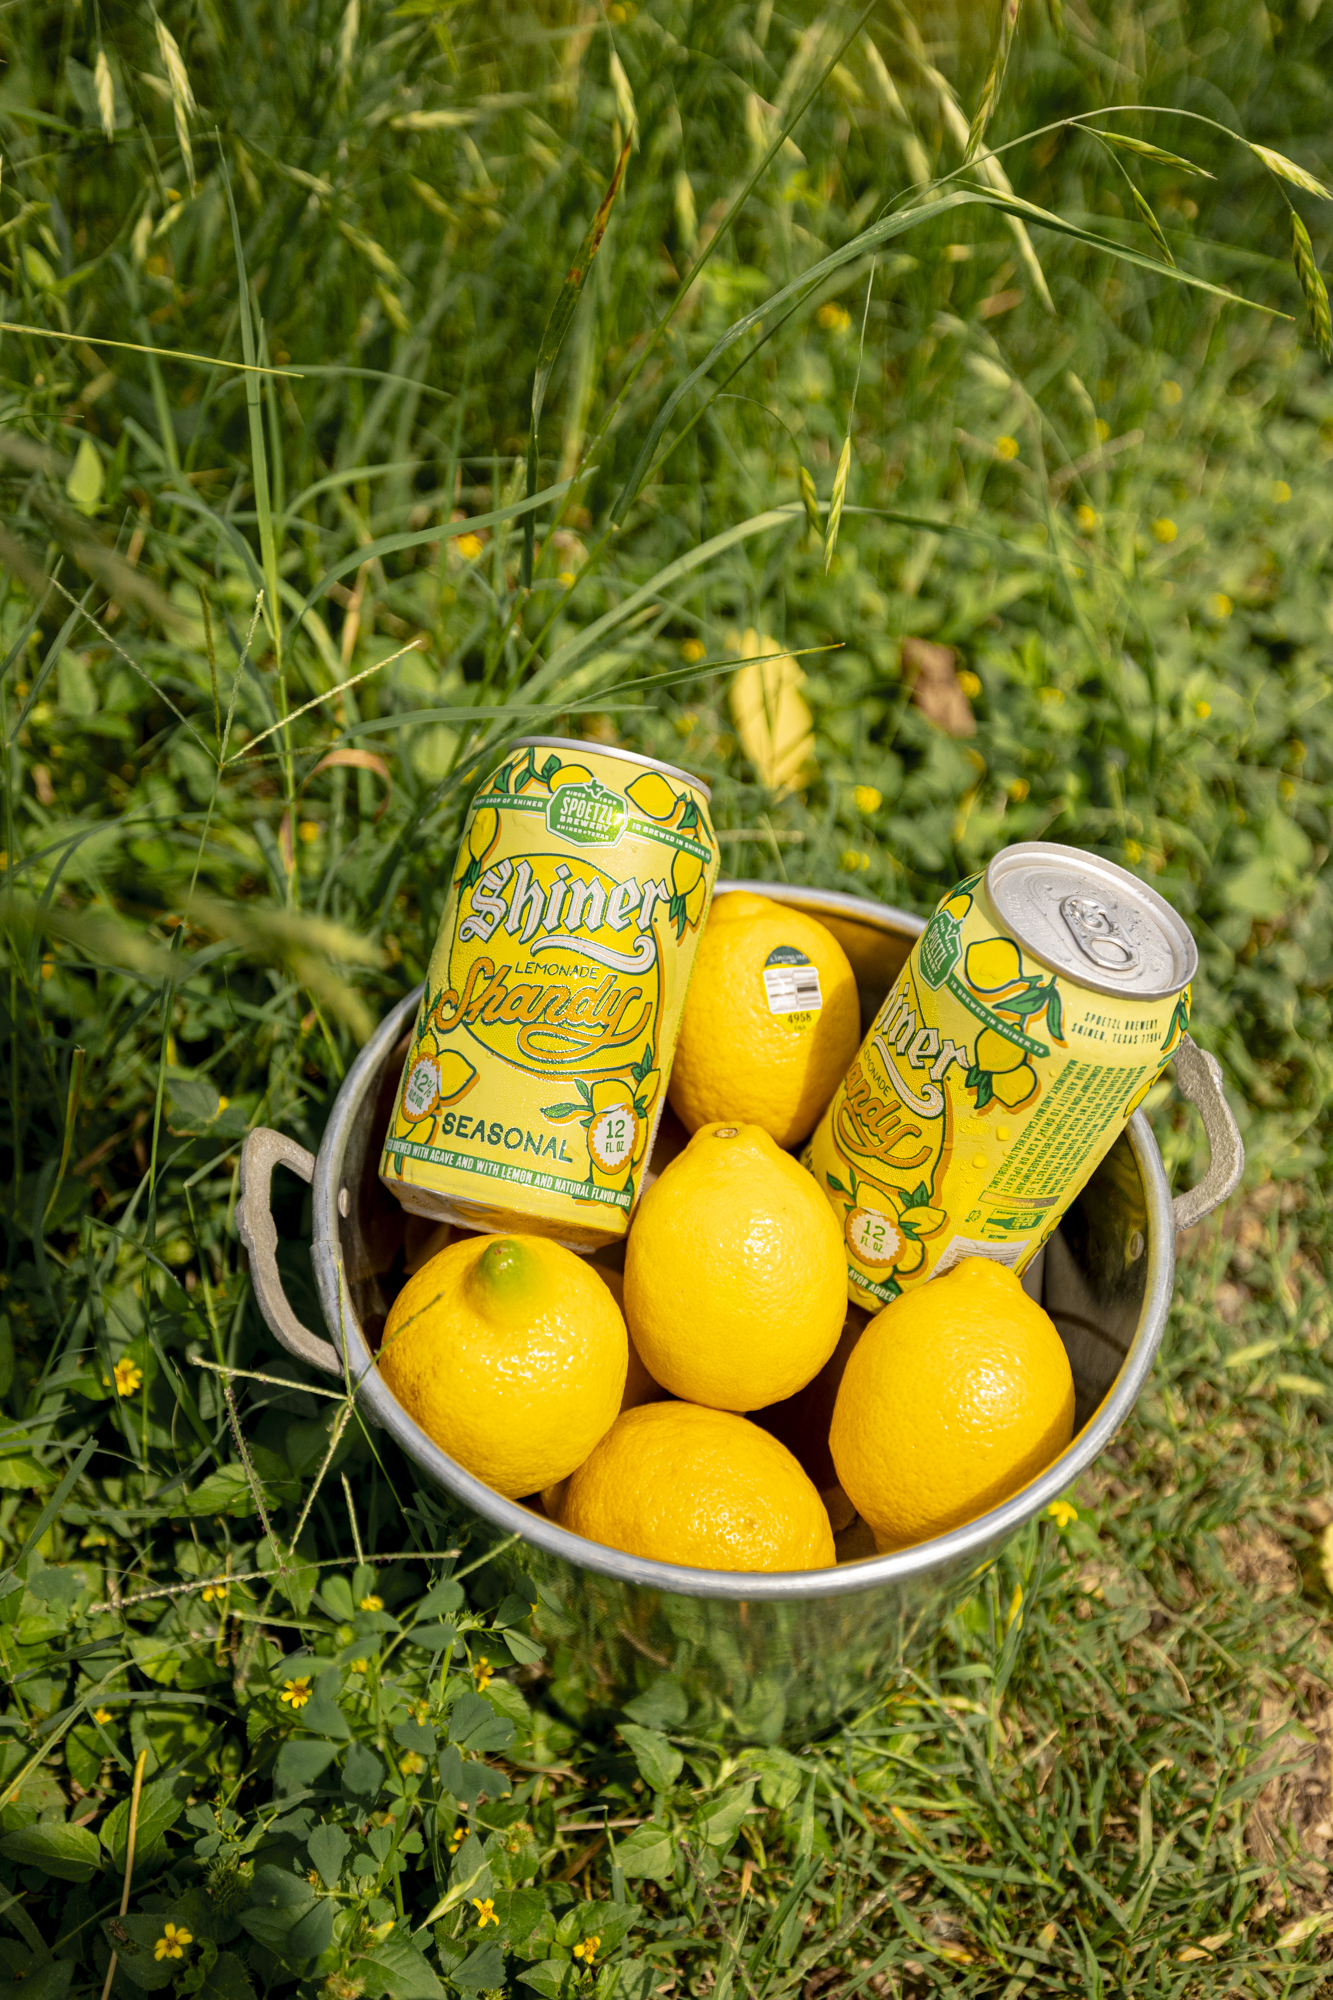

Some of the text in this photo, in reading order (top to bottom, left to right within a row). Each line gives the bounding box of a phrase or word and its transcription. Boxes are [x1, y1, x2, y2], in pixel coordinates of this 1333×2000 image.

[513, 798, 543, 808] SHINER
[560, 796, 614, 826] SPOETZL
[559, 815, 610, 832] BREWERY
[632, 822, 641, 831] IS
[643, 826, 675, 842] BREWED
[675, 838, 684, 846] IN
[458, 858, 671, 945] Shiner
[515, 961, 600, 979] LEMONADE
[434, 956, 653, 1065] Shandy
[787, 1012, 812, 1024] 4958
[950, 980, 1046, 1055] IS BREWED IN SHINER, TX
[1084, 1012, 1158, 1030] SPOETZL BREWERY
[1071, 1023, 1108, 1043] SHINER,
[1112, 1033, 1139, 1045] TEXAS
[1073, 1063, 1091, 1080] YOUR
[1090, 1067, 1116, 1094] BECAUSE
[1039, 1094, 1055, 1108] AND
[1055, 1081, 1079, 1106] ABILITY
[1031, 1107, 1047, 1121] MAY
[1049, 1108, 1061, 1116] TO
[606, 1119, 625, 1139] 12
[1019, 1120, 1039, 1139] CAUSE
[1036, 1117, 1055, 1135] DRIVE
[442, 1112, 574, 1164] SEASONAL
[605, 1142, 615, 1153] FL.
[1006, 1138, 1027, 1160] HEALTH
[1023, 1143, 1039, 1155] CAR
[1026, 1142, 1053, 1172] BEVERAGES
[1048, 1141, 1066, 1158] BIRTH
[1017, 1156, 1030, 1165] OR
[392, 1140, 411, 1155] BREWED
[411, 1145, 429, 1160] WITH
[428, 1149, 455, 1166] AGAVE
[455, 1155, 475, 1170] AND
[476, 1158, 500, 1177] WITH
[501, 1166, 532, 1184] LEMON
[534, 1173, 553, 1189] AND
[554, 1180, 589, 1198] NATURAL
[590, 1187, 616, 1204] FLAVOR
[1000, 1166, 1023, 1192] OPERATE
[863, 1220, 886, 1242] 12
[860, 1235, 871, 1249] FL.
[868, 1283, 897, 1302] ADDED
